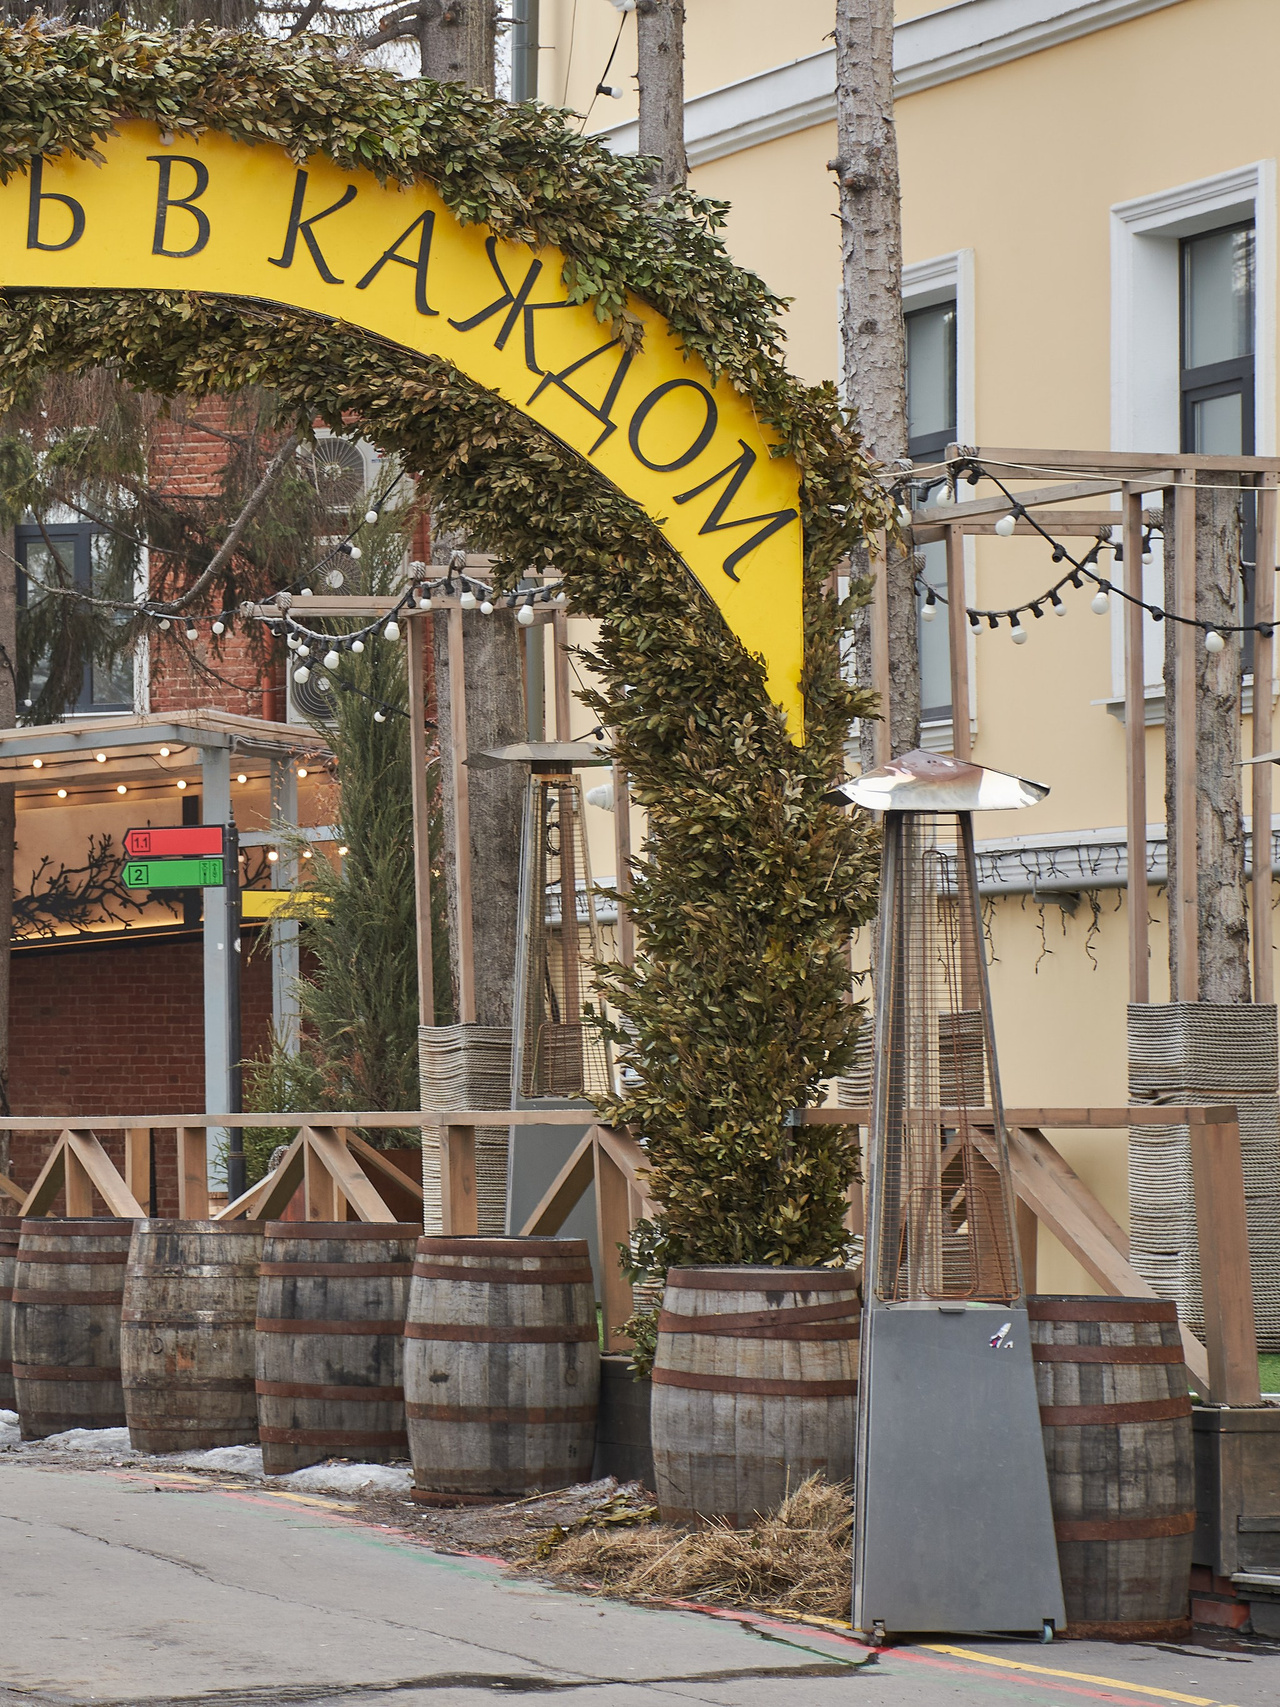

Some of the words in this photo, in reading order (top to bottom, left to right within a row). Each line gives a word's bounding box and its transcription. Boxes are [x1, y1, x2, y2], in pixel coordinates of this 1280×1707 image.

[146, 154, 212, 259] В
[267, 168, 799, 584] КАЖДОМ
[134, 837, 148, 849] 1.1
[134, 868, 143, 881] 2
